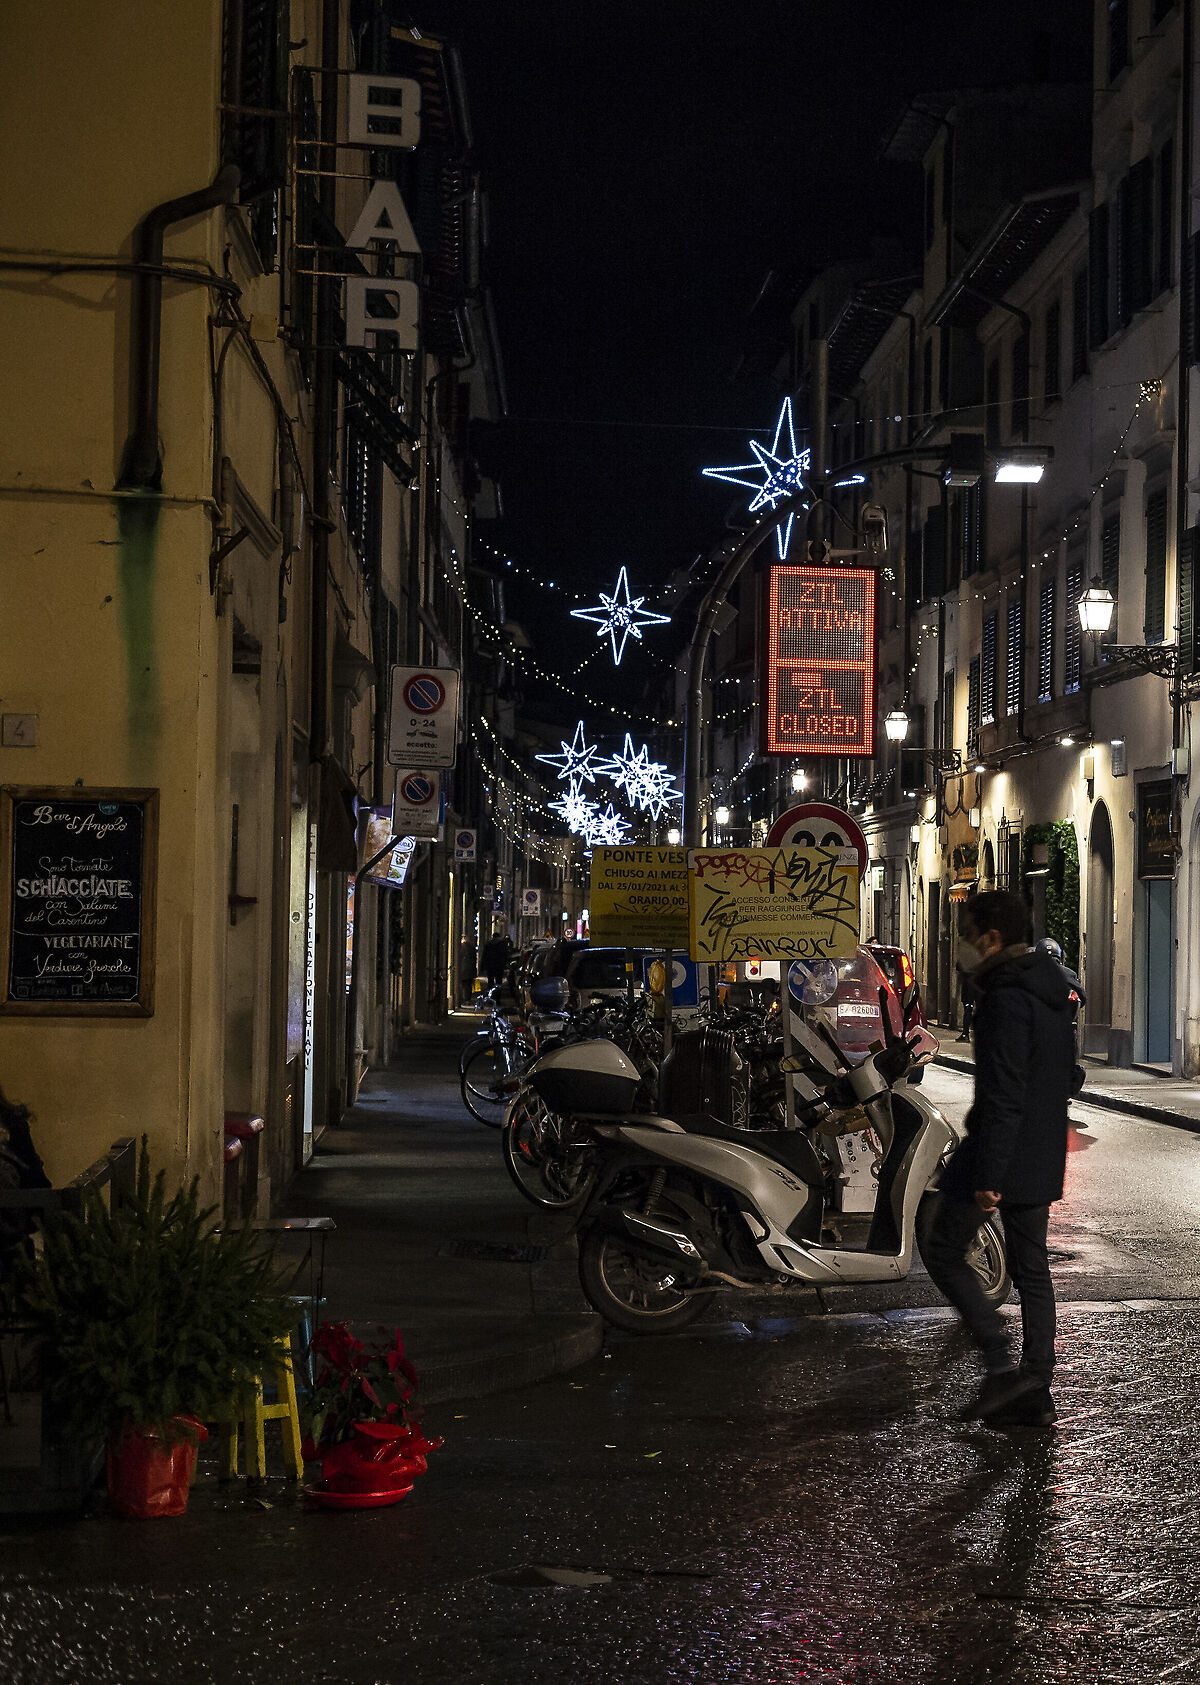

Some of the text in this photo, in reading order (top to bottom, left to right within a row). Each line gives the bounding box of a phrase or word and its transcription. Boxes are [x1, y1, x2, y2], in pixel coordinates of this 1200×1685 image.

[347, 73, 422, 351] BAR
[800, 583, 843, 603] ZTL
[779, 608, 862, 630] ATTIVA
[799, 688, 842, 708] ZTL
[780, 714, 858, 736] CLOSED
[20, 805, 71, 826] Bar
[603, 850, 687, 864] PONTE VES
[604, 868, 644, 878] CHIUSO
[661, 870, 688, 879] MEZZ
[16, 874, 133, 899] SCHIACCIATE
[616, 882, 666, 892] 25/01/2021
[629, 895, 688, 905] ORARIO 00-
[731, 895, 826, 904] ACCESSO CONSENTO
[24, 910, 44, 922] del
[739, 905, 755, 913] PER
[43, 935, 134, 949] VEGETARIANE
